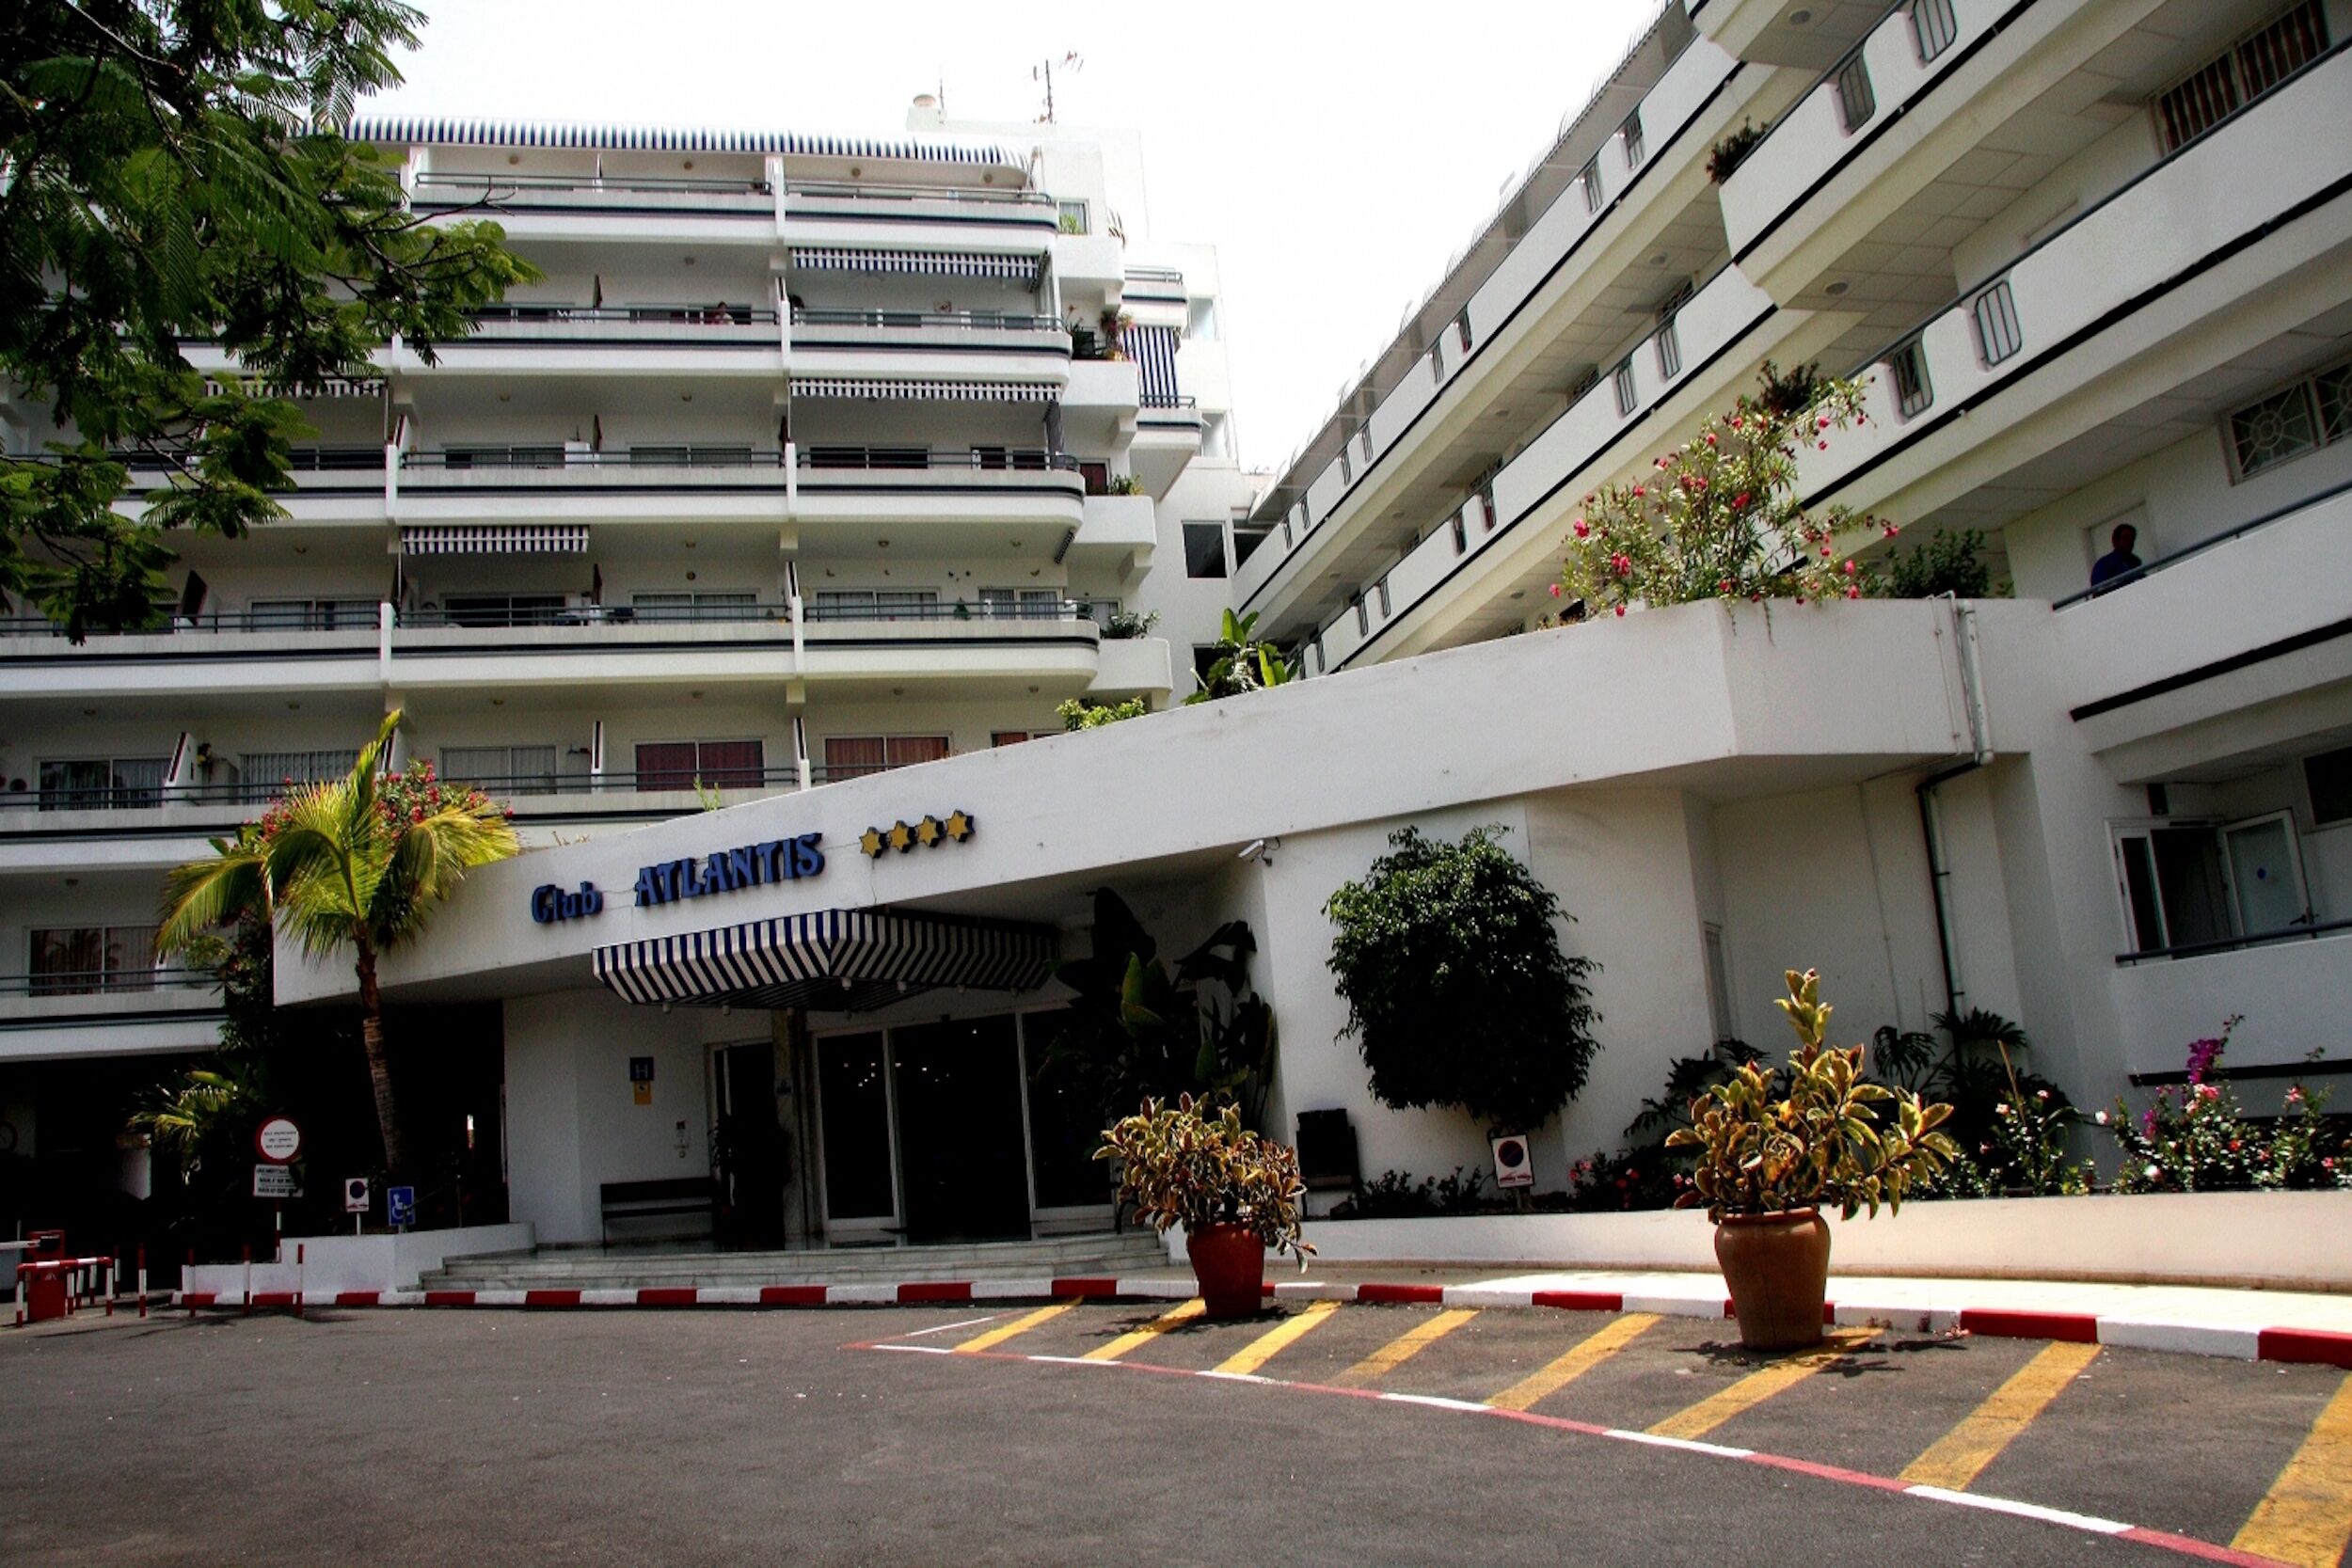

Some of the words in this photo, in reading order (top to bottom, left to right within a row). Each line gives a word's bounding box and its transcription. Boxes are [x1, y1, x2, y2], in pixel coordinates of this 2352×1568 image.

[532, 880, 603, 924] Club
[634, 832, 825, 907] ATLANTIS
[635, 1064, 648, 1079] H
